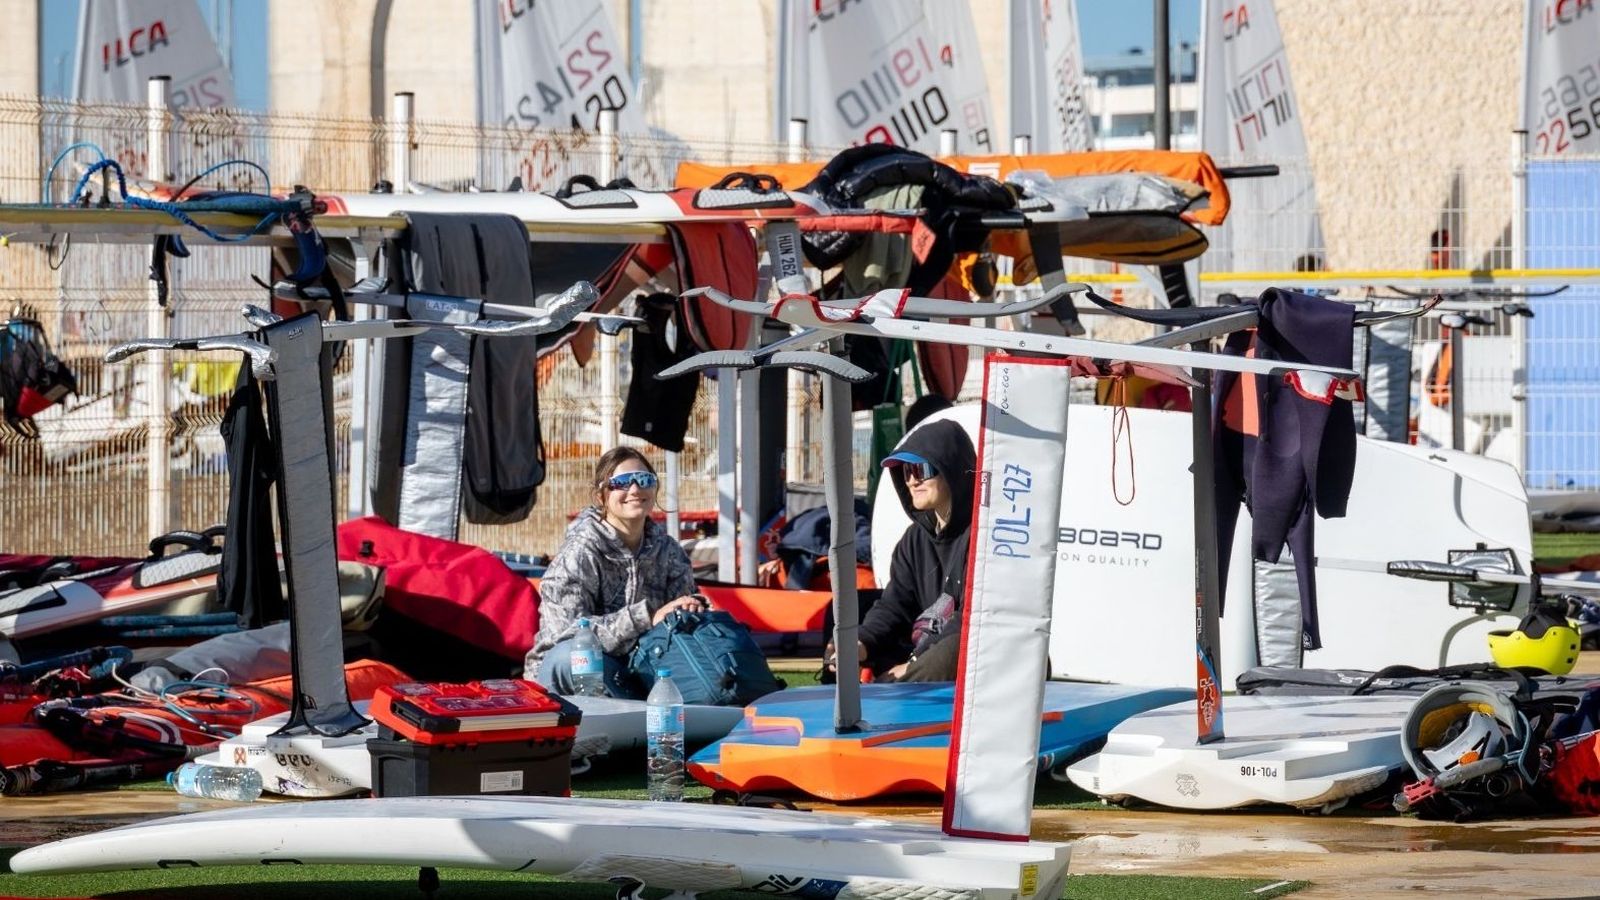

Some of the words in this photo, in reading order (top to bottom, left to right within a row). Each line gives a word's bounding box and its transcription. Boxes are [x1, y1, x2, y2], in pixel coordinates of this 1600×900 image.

[102, 20, 169, 72] ILCA
[778, 233, 794, 255] HUN
[781, 257, 797, 278] 262
[991, 463, 1032, 560] POL-427
[1087, 554, 1150, 568] QUALITY
[1240, 765, 1278, 778] POL-106
